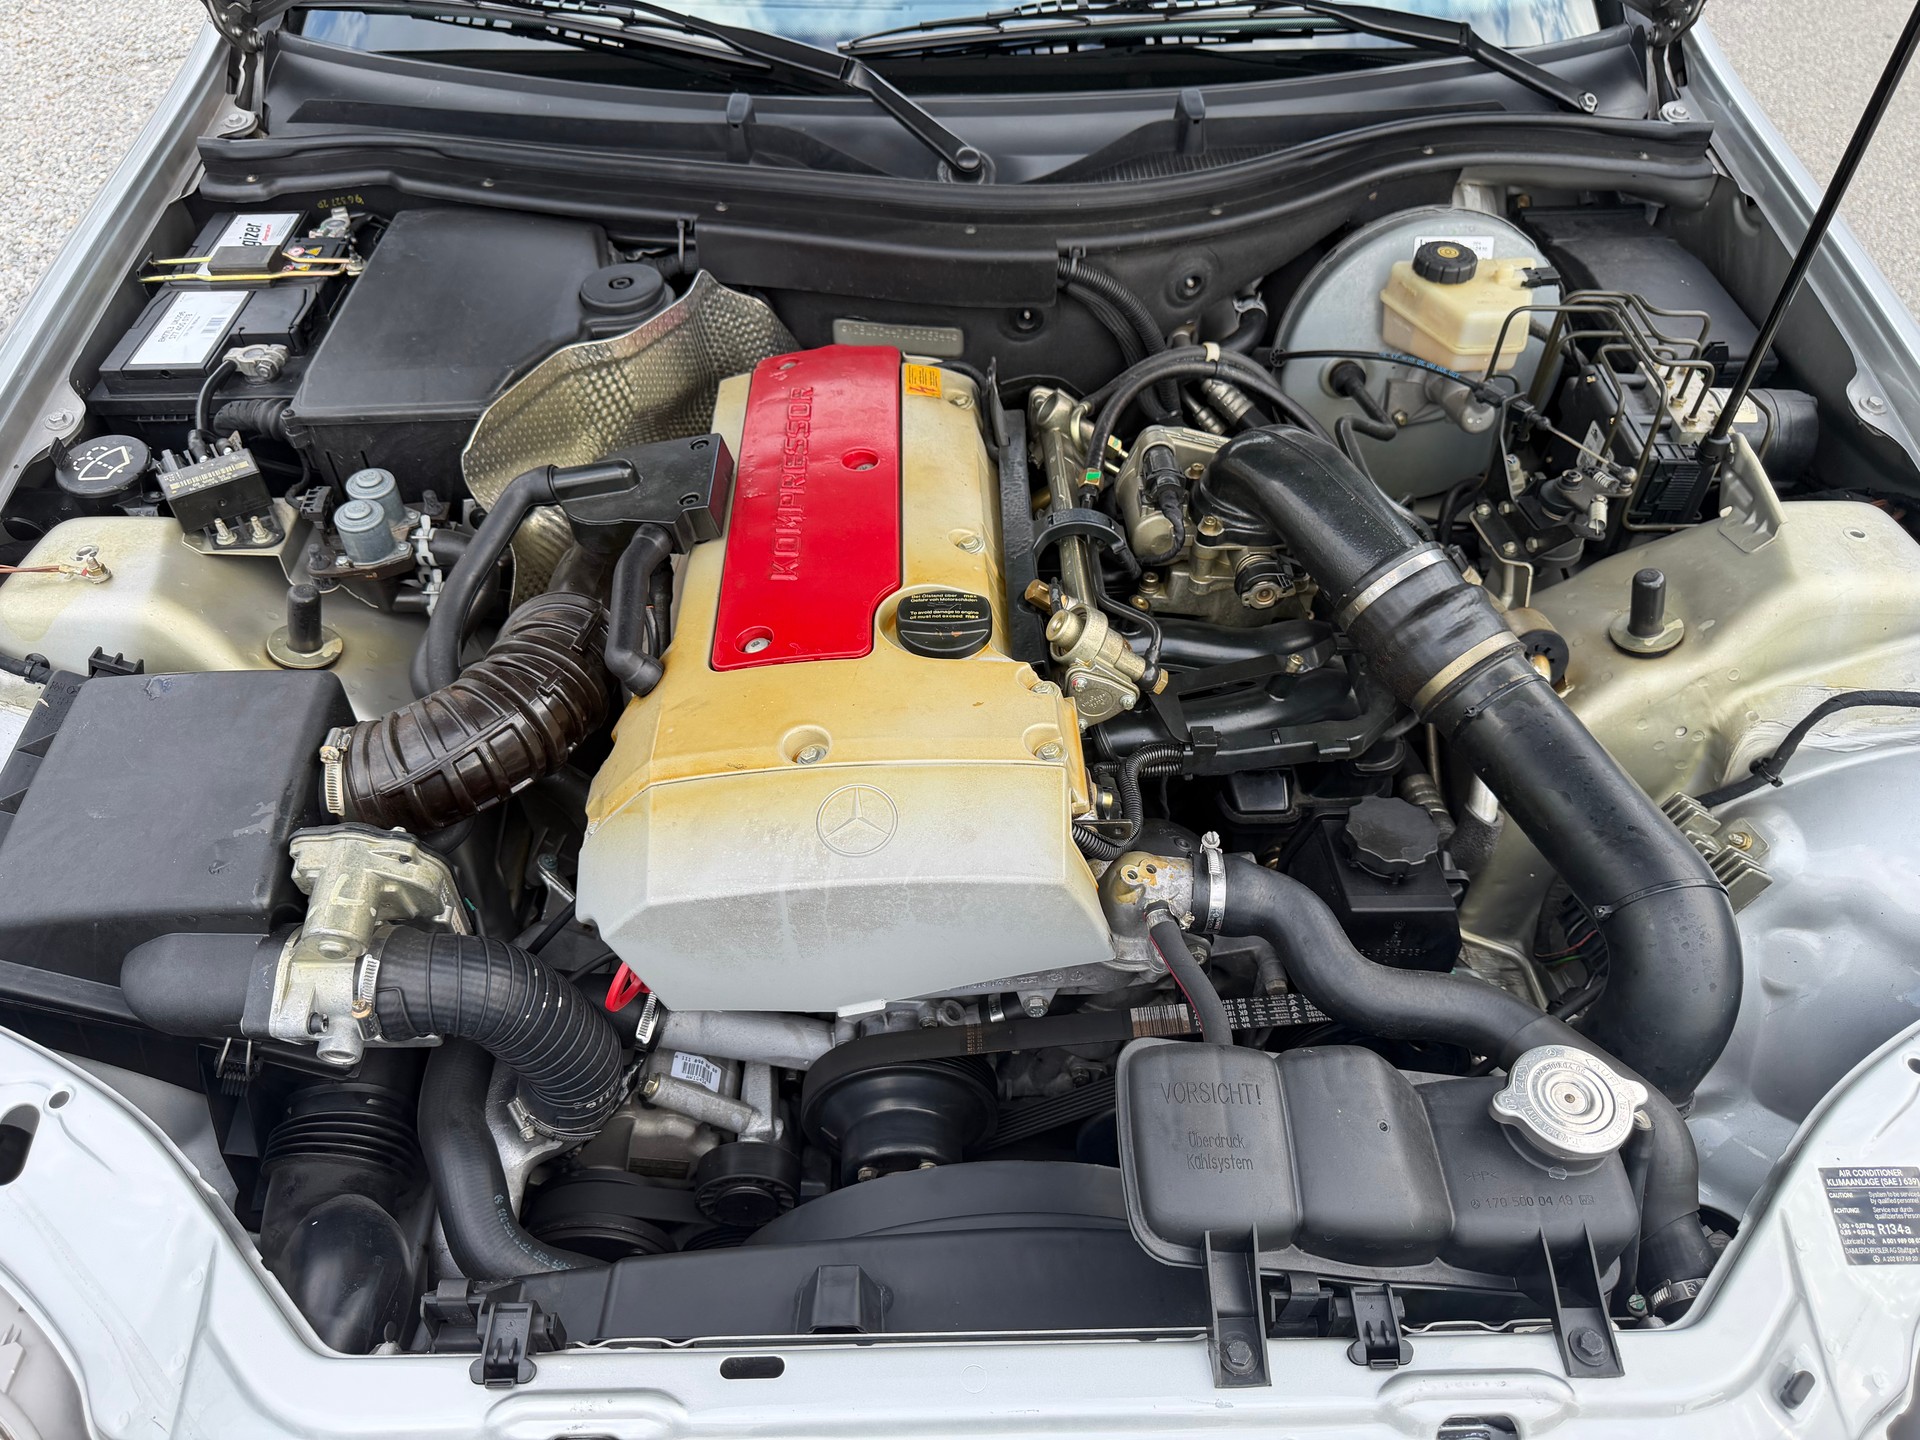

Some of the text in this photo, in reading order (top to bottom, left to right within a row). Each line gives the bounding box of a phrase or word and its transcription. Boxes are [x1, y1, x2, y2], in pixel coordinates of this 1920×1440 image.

[769, 386, 814, 581] KOMPRESSOR
[1160, 1081, 1262, 1105] VORSICHT!
[1527, 1107, 1542, 1126] AUF
[1188, 1128, 1246, 1149] Überdruck
[1839, 1168, 1904, 1177] AIR CONDITIONER
[1826, 1177, 1880, 1187] KLIMAANLAGE
[1880, 1177, 1898, 1188] (SAE
[1903, 1177, 1920, 1188] 639)
[1868, 1191, 1888, 1199] System
[1486, 1197, 1508, 1209] 170
[1512, 1195, 1534, 1208] 500
[1538, 1195, 1553, 1207] 04
[1877, 1223, 1912, 1235] R134a
[1897, 1246, 1919, 1254] Stuttgart
